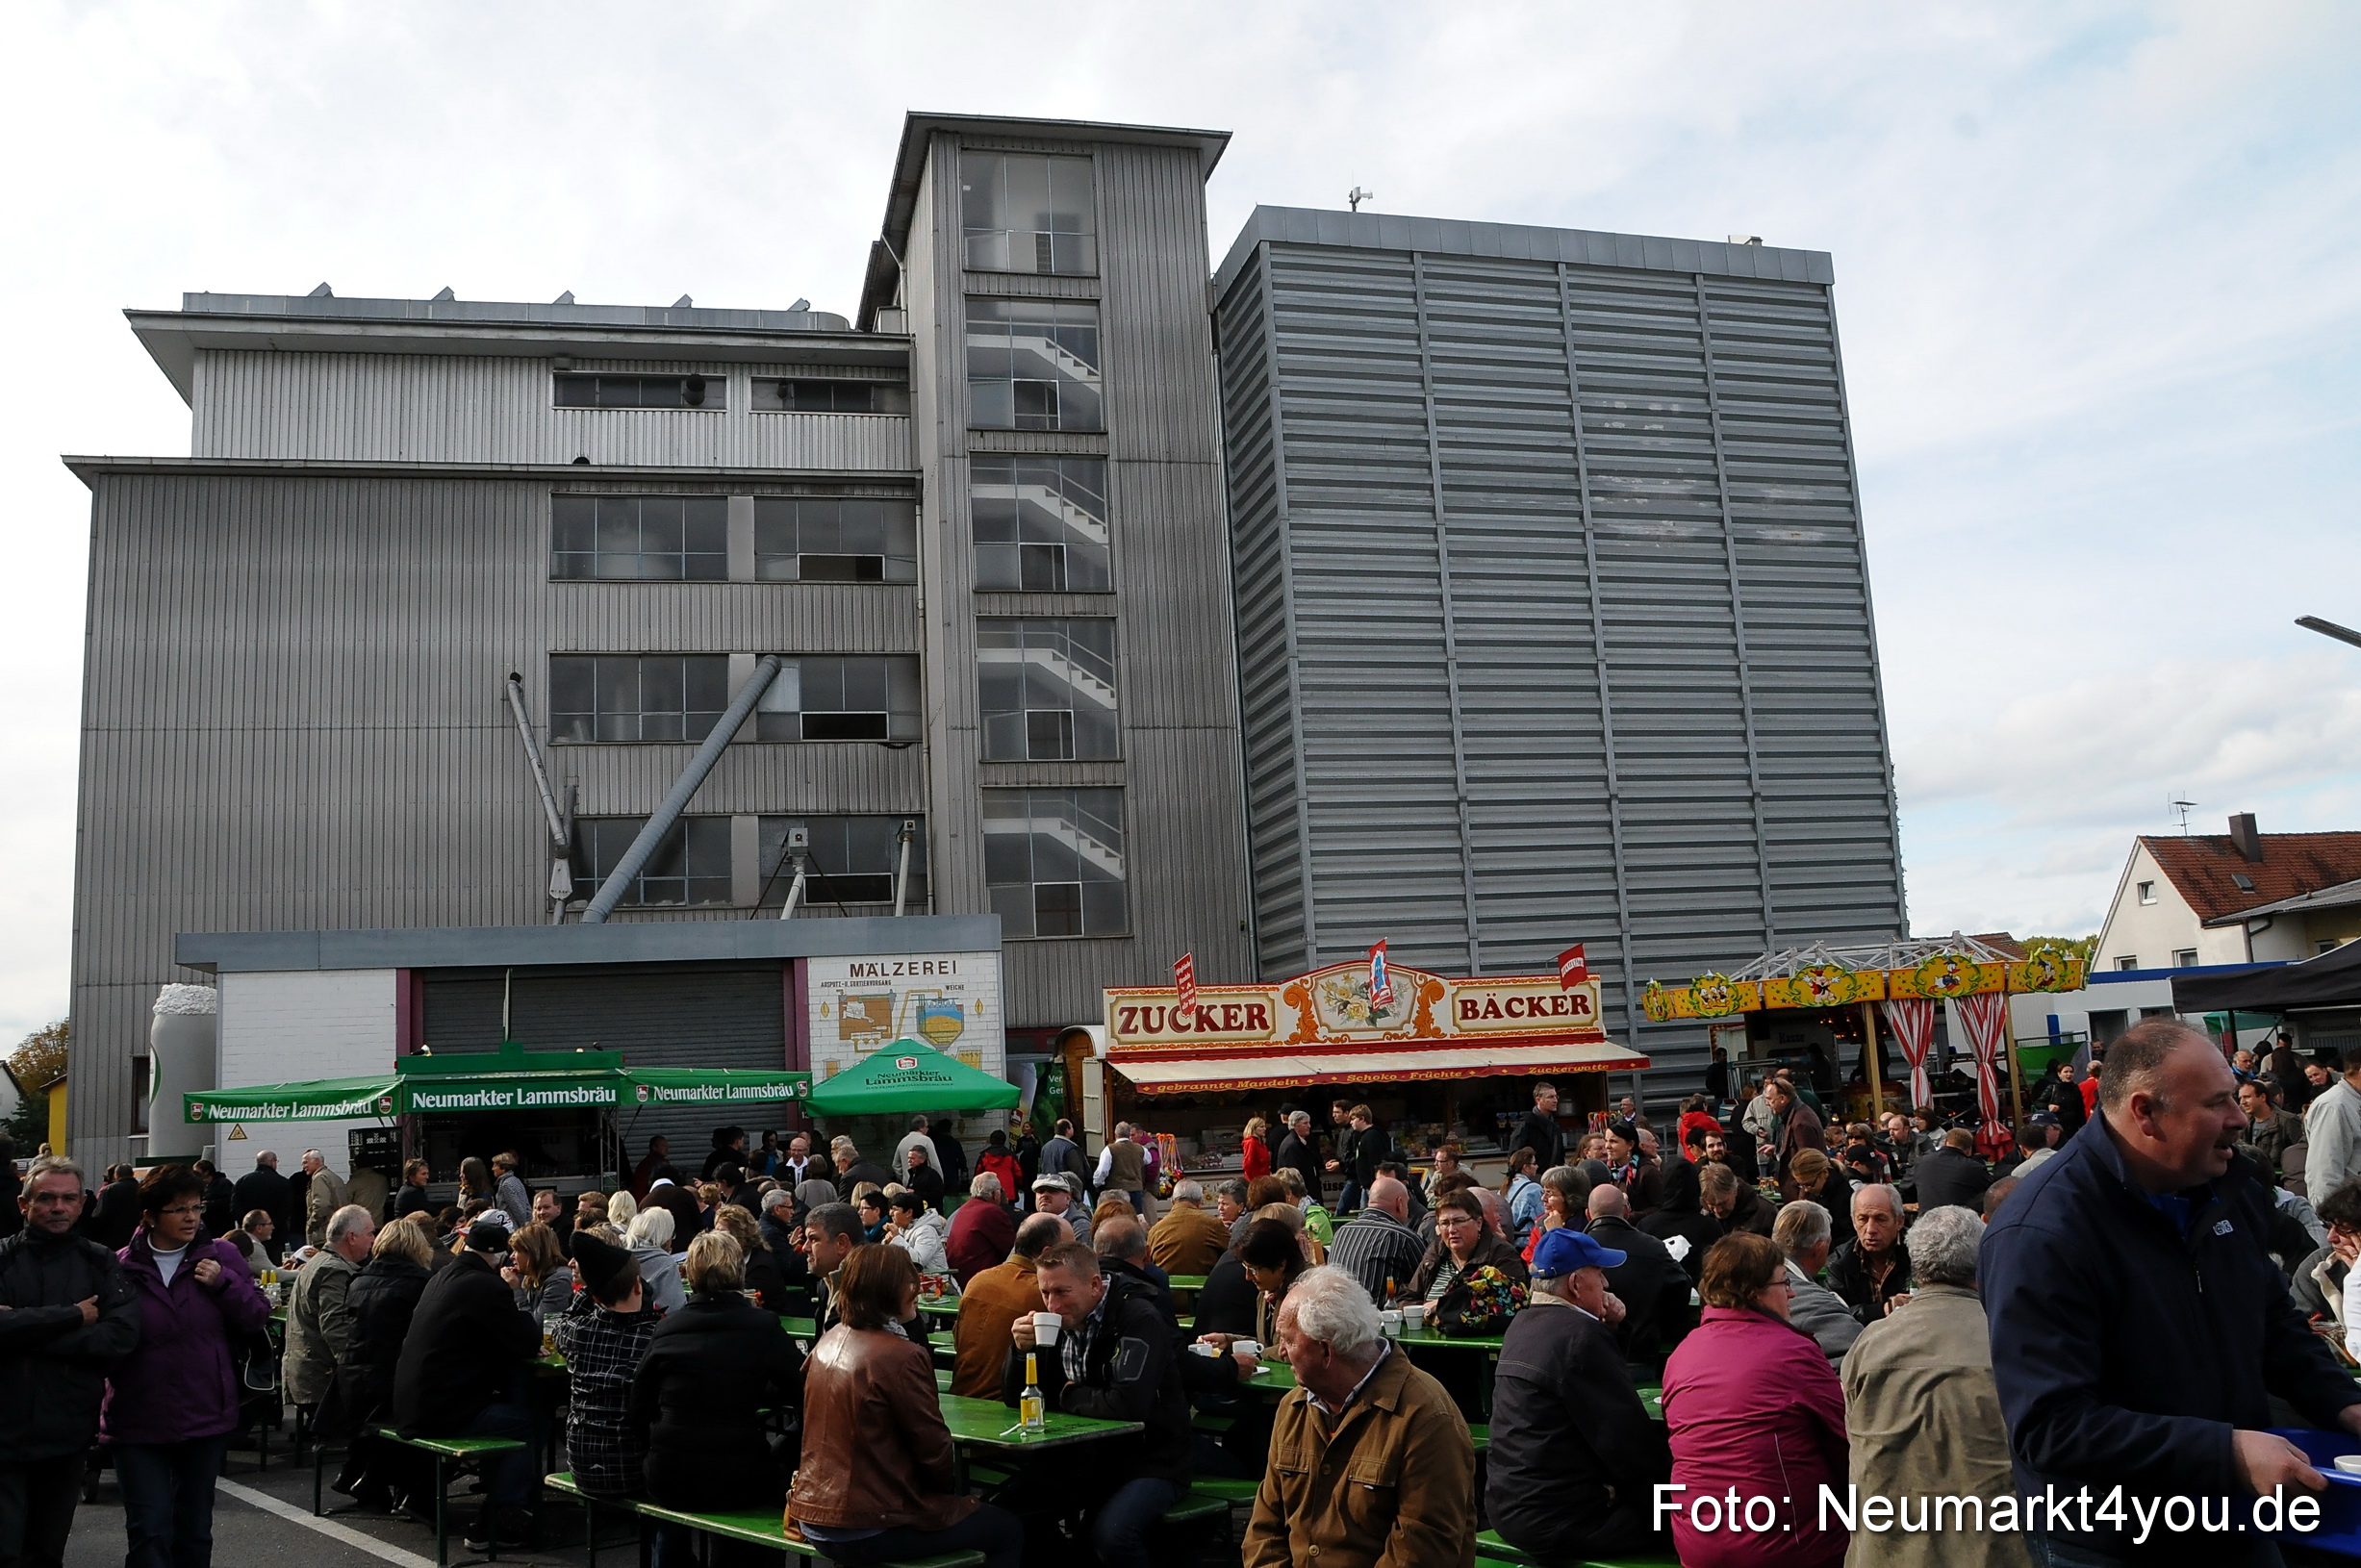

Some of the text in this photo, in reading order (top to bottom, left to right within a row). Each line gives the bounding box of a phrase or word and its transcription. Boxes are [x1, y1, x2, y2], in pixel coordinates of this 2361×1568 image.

[850, 960, 957, 977] MÄLZEREI
[1459, 993, 1591, 1021] BÄCKER
[1117, 1003, 1270, 1035] ZUCKER
[1346, 1074, 1398, 1082] Schoko
[1409, 1070, 1462, 1079] Früchte
[1528, 1063, 1610, 1075] Zuckerwatte
[866, 1075, 952, 1086] Lammsbräu
[1157, 1078, 1299, 1093] gebrannte Mandeln
[413, 1086, 617, 1108] Neumarkter Lammsbräu
[653, 1082, 795, 1101] Neumarkter Lammsbräu
[209, 1100, 372, 1120] Neumarkter Lammsbräu
